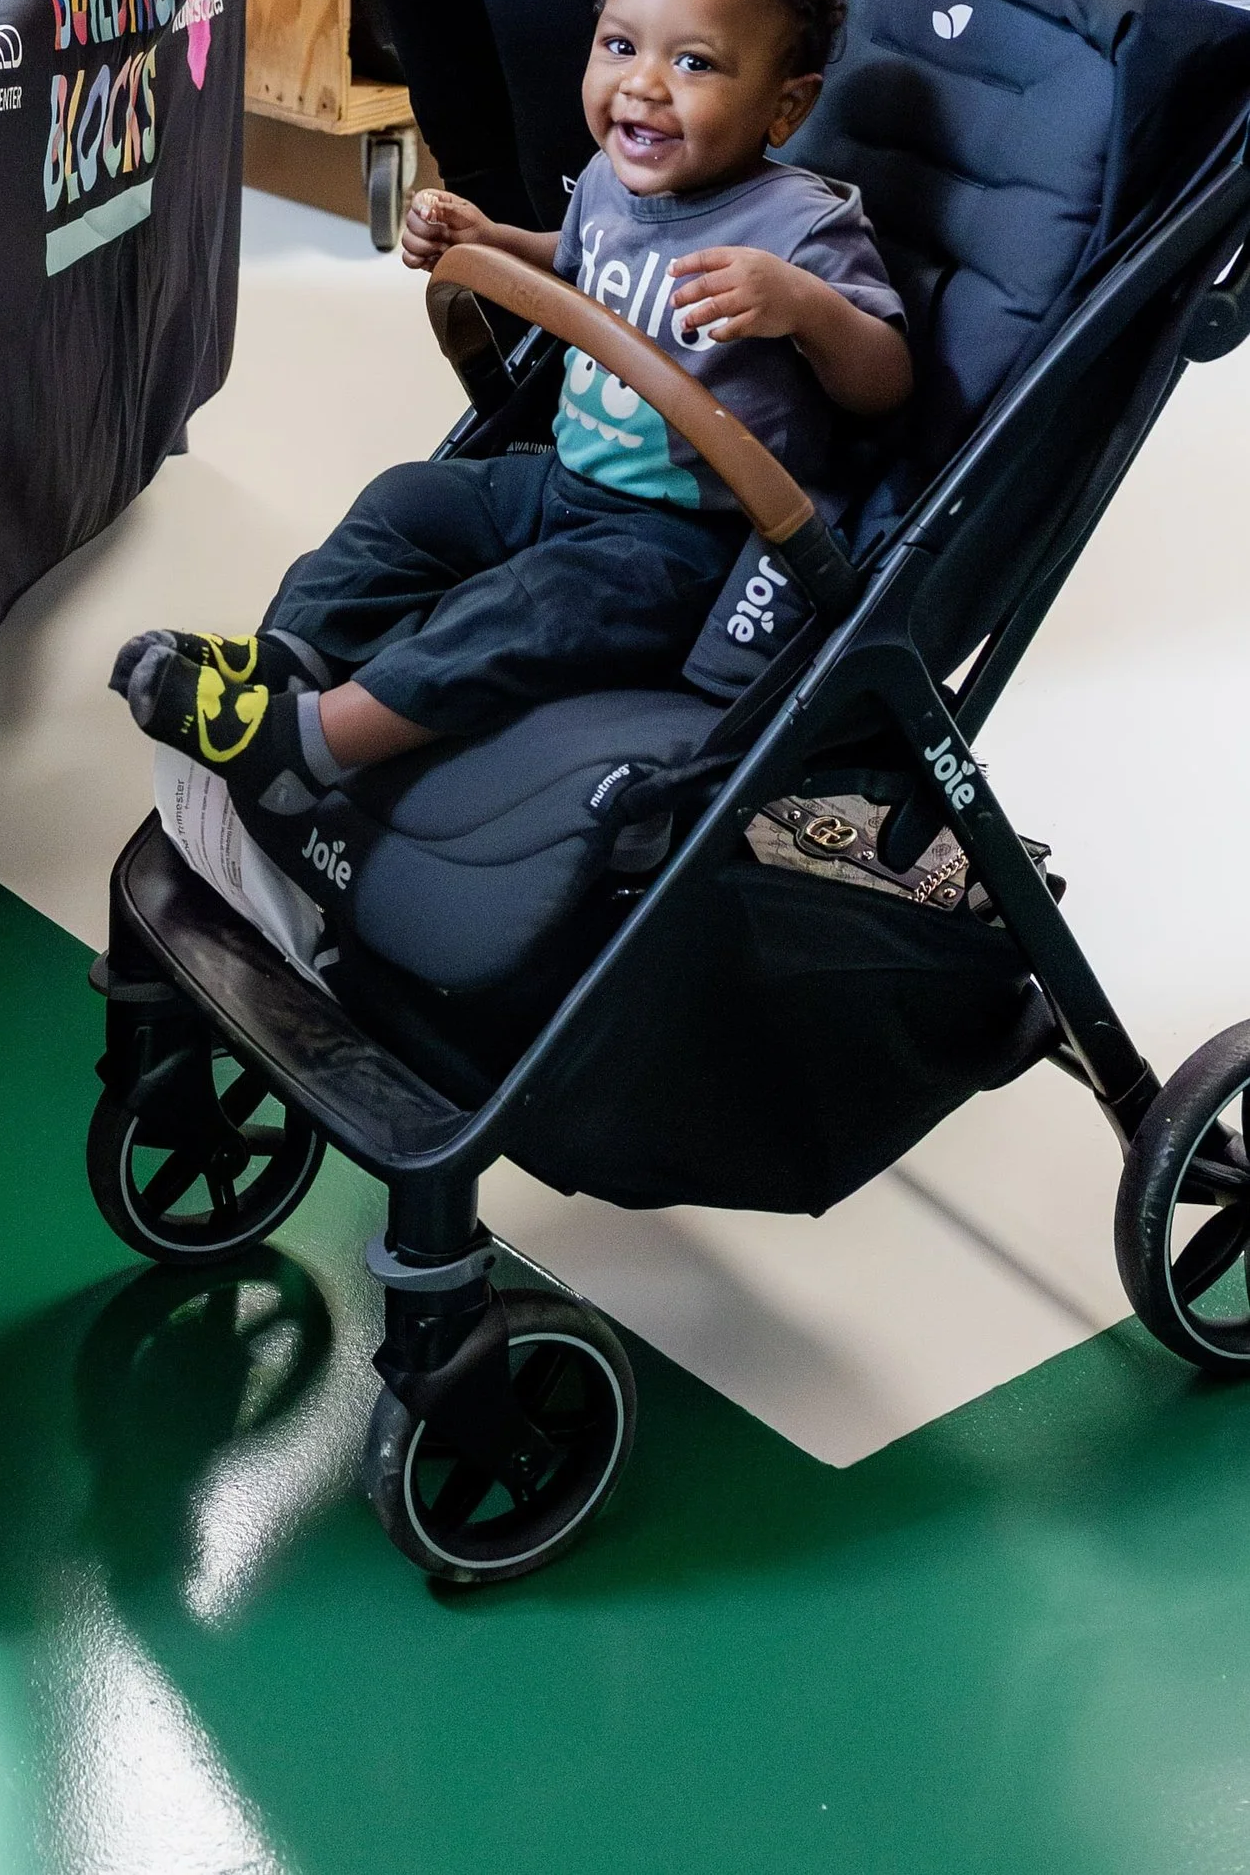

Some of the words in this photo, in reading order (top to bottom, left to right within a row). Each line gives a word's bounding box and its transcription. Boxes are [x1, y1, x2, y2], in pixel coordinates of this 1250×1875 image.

[43, 43, 158, 212] BLOCKS
[726, 555, 788, 643] Joie
[590, 763, 630, 808] nutmeg
[924, 736, 976, 810] Joie
[301, 826, 352, 890] Joie
